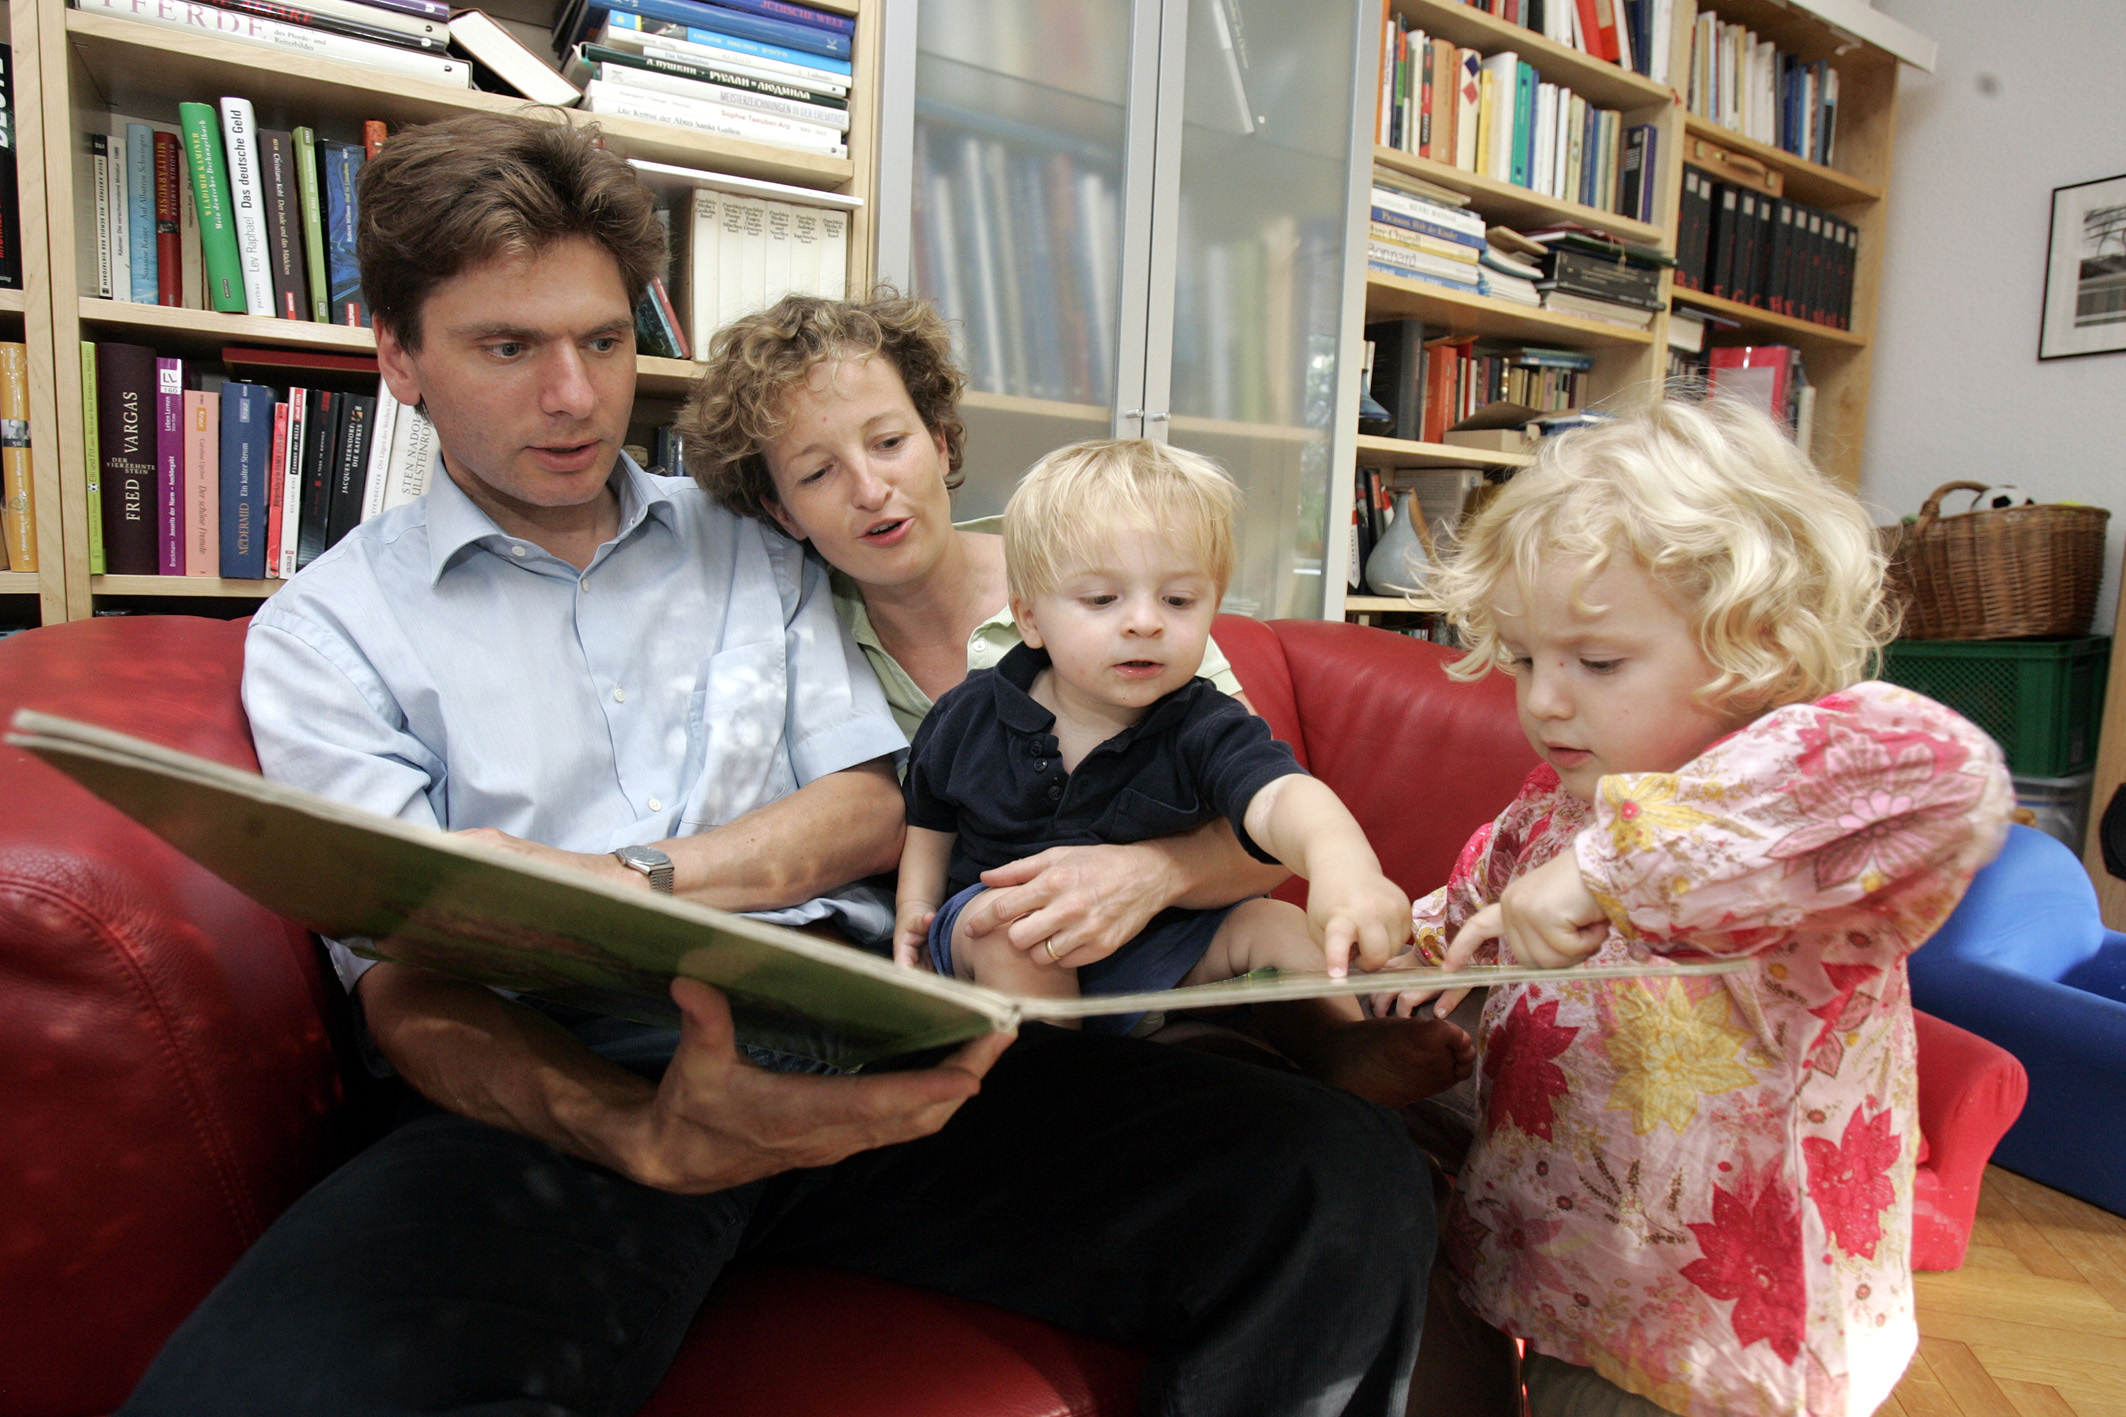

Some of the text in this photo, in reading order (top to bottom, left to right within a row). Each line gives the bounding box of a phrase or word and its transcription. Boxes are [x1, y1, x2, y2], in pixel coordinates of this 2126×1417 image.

[760, 0, 845, 28] JÜDISCHE WELT
[722, 110, 746, 121] Sophie
[138, 134, 147, 175] Schwingen
[273, 153, 283, 183] Christiane
[157, 142, 168, 216] MILITÄRMUSIK
[192, 132, 212, 216] WLADIMIR KAMINER
[201, 120, 224, 230] Mein deutsches Dschungelbuch
[230, 110, 261, 273] Lev Raphael Das deutsche Geld
[276, 183, 285, 197] Kohl
[140, 207, 148, 220] Auf
[278, 200, 286, 210] Der
[280, 225, 288, 237] und
[142, 250, 150, 281] Susanne
[88, 446, 96, 456] Pit
[240, 442, 248, 464] Strom
[354, 424, 362, 454] RAFFKES
[106, 462, 156, 471] VIERZEHNTE
[122, 391, 140, 521] FRED VARGAS
[240, 464, 248, 485] kalter
[342, 463, 350, 494] JACQUES
[402, 463, 414, 494] STEN
[240, 486, 248, 497] Ein
[198, 526, 206, 554] Fremde
